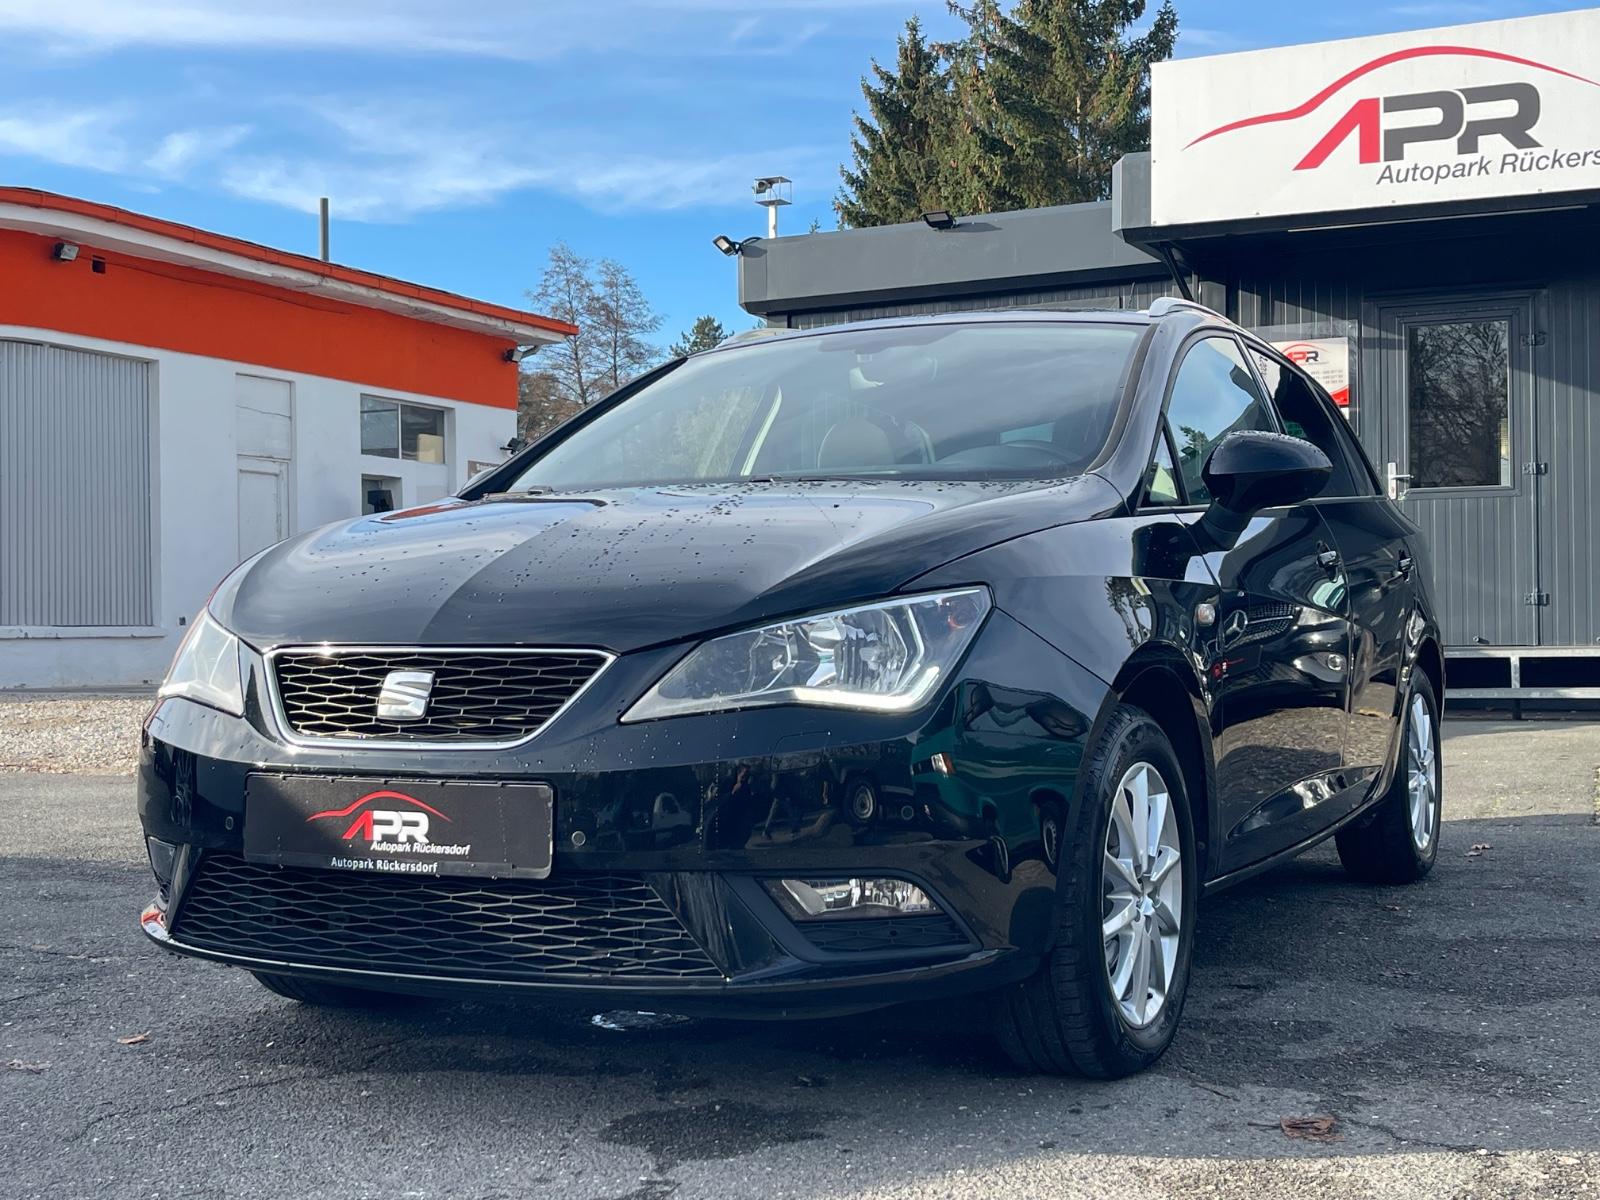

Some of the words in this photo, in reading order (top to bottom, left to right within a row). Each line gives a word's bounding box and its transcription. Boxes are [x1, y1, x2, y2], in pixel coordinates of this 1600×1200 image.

[1293, 82, 1543, 172] APR
[1376, 156, 1493, 185] Autopark
[342, 810, 430, 844] APR
[370, 840, 411, 853] Autopark
[412, 841, 471, 856] Rückersdorf
[331, 856, 375, 871] Autopark
[376, 859, 439, 873] Rückersdorf
